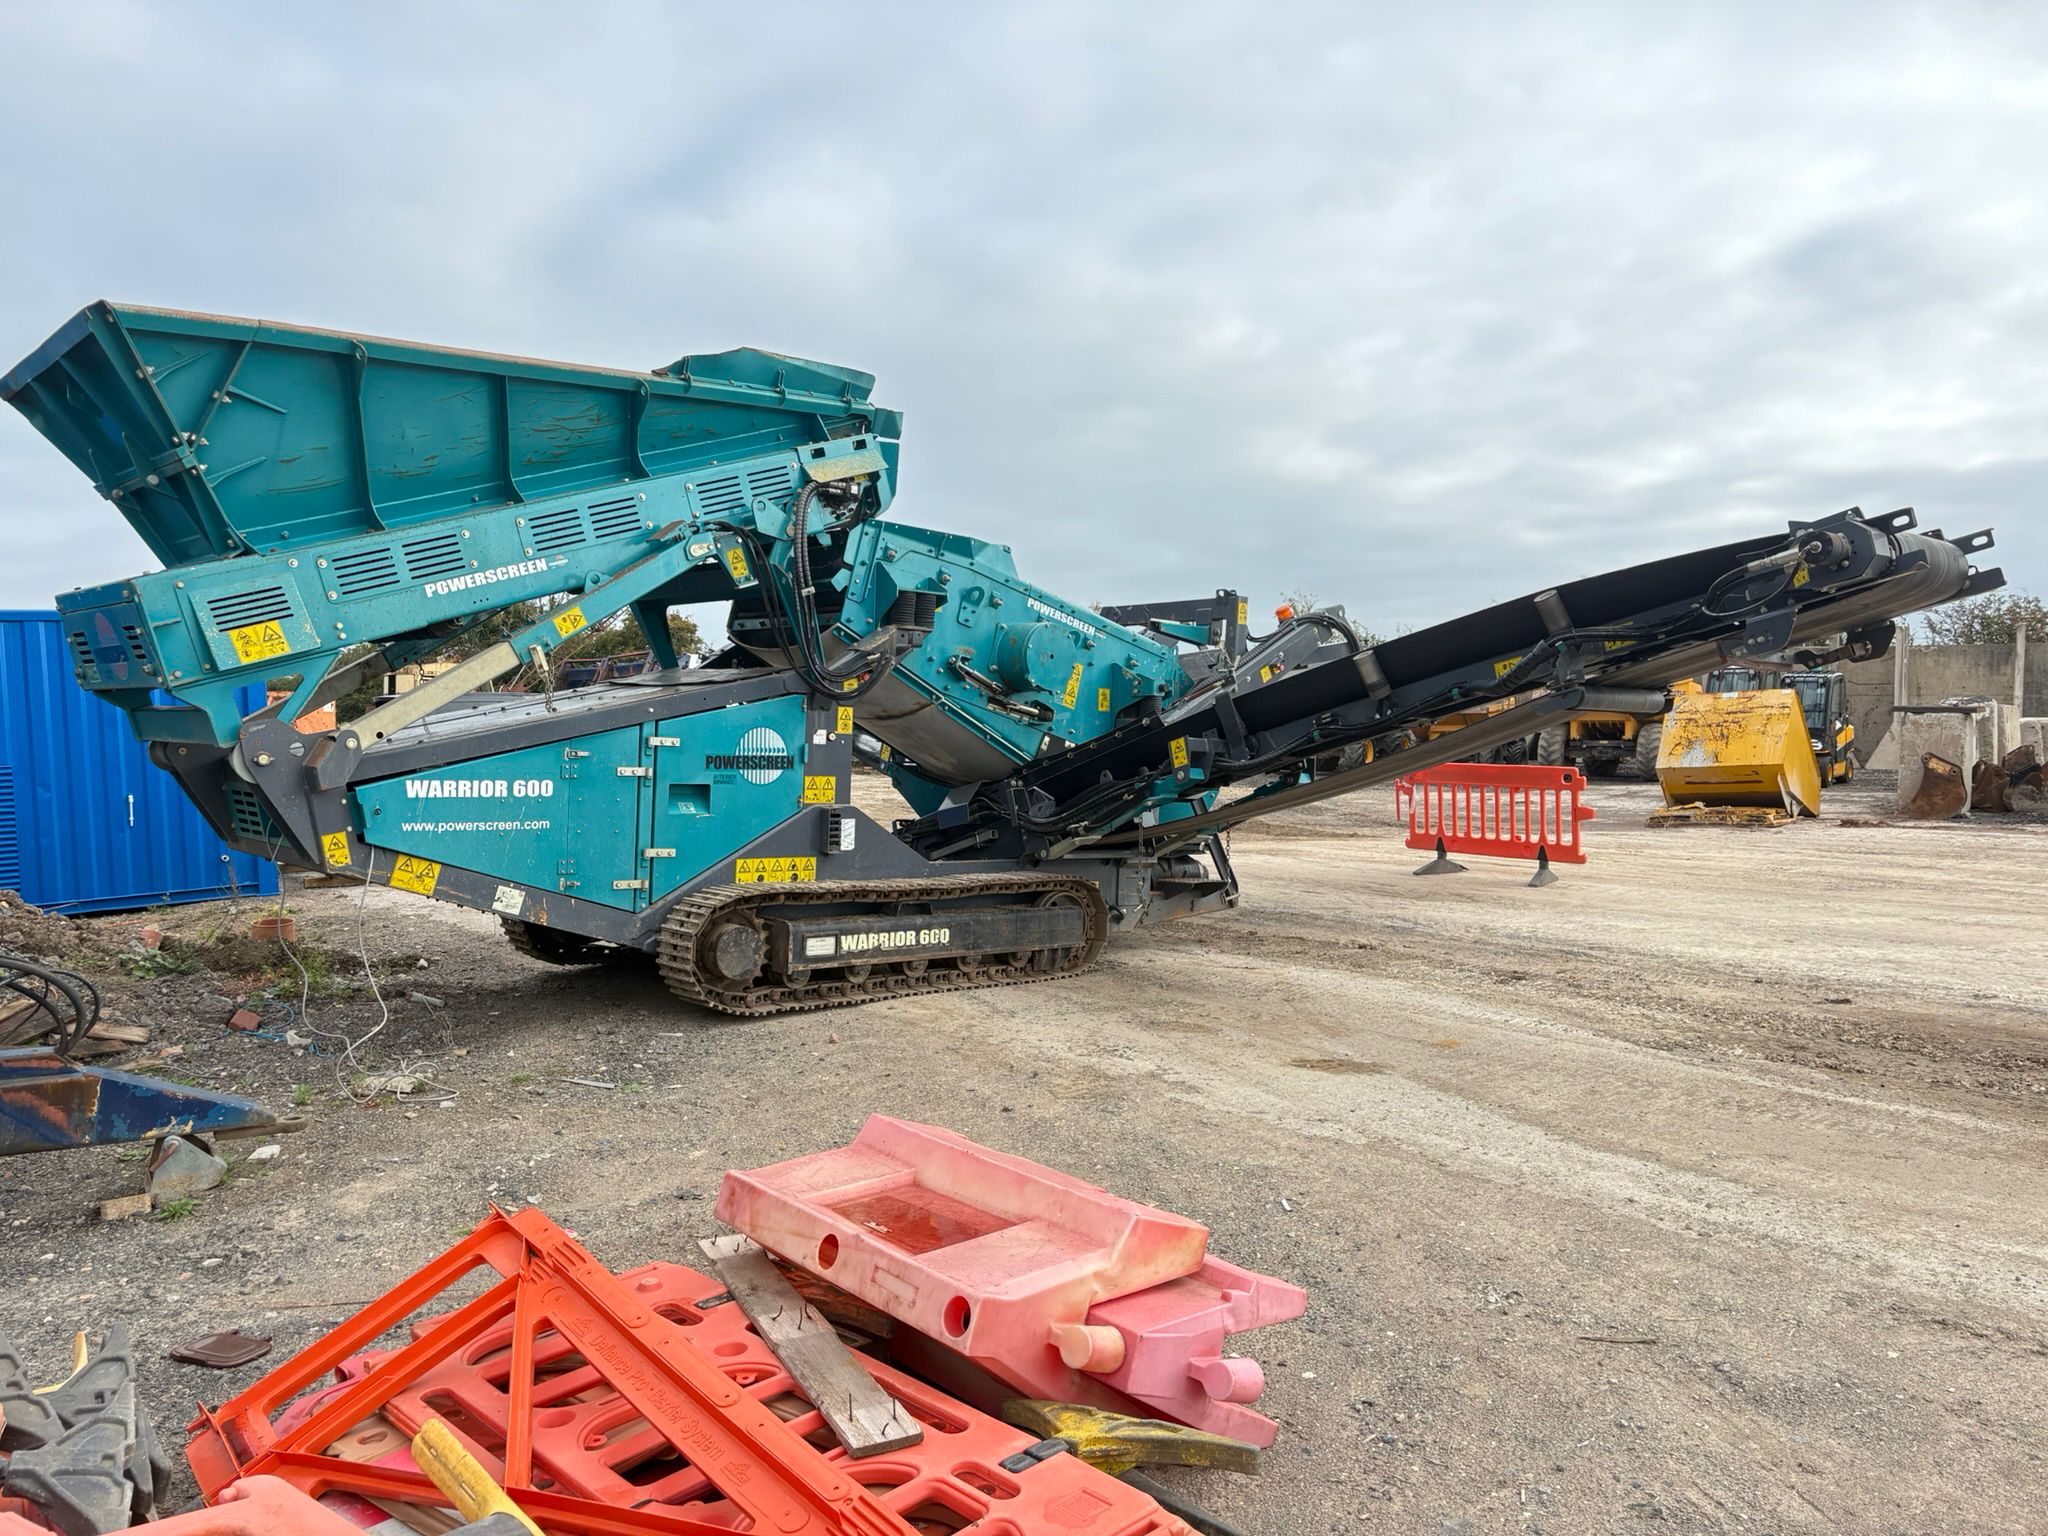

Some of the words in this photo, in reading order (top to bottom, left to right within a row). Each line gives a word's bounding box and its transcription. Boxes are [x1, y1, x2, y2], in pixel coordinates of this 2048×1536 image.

[424, 558, 548, 598] POWERSCREEN
[1027, 598, 1096, 636] POWERSCREEN
[705, 755, 794, 769] POWERSCREEN
[405, 780, 508, 798] WARRIOR
[513, 780, 554, 797] 600
[401, 820, 550, 833] www.powerscreen.com
[840, 930, 916, 950] WARRIOR
[919, 928, 950, 944] 600
[589, 1334, 633, 1376] Defiance
[630, 1369, 650, 1392] Pro
[648, 1389, 687, 1425] Barrier
[680, 1418, 726, 1462] System
